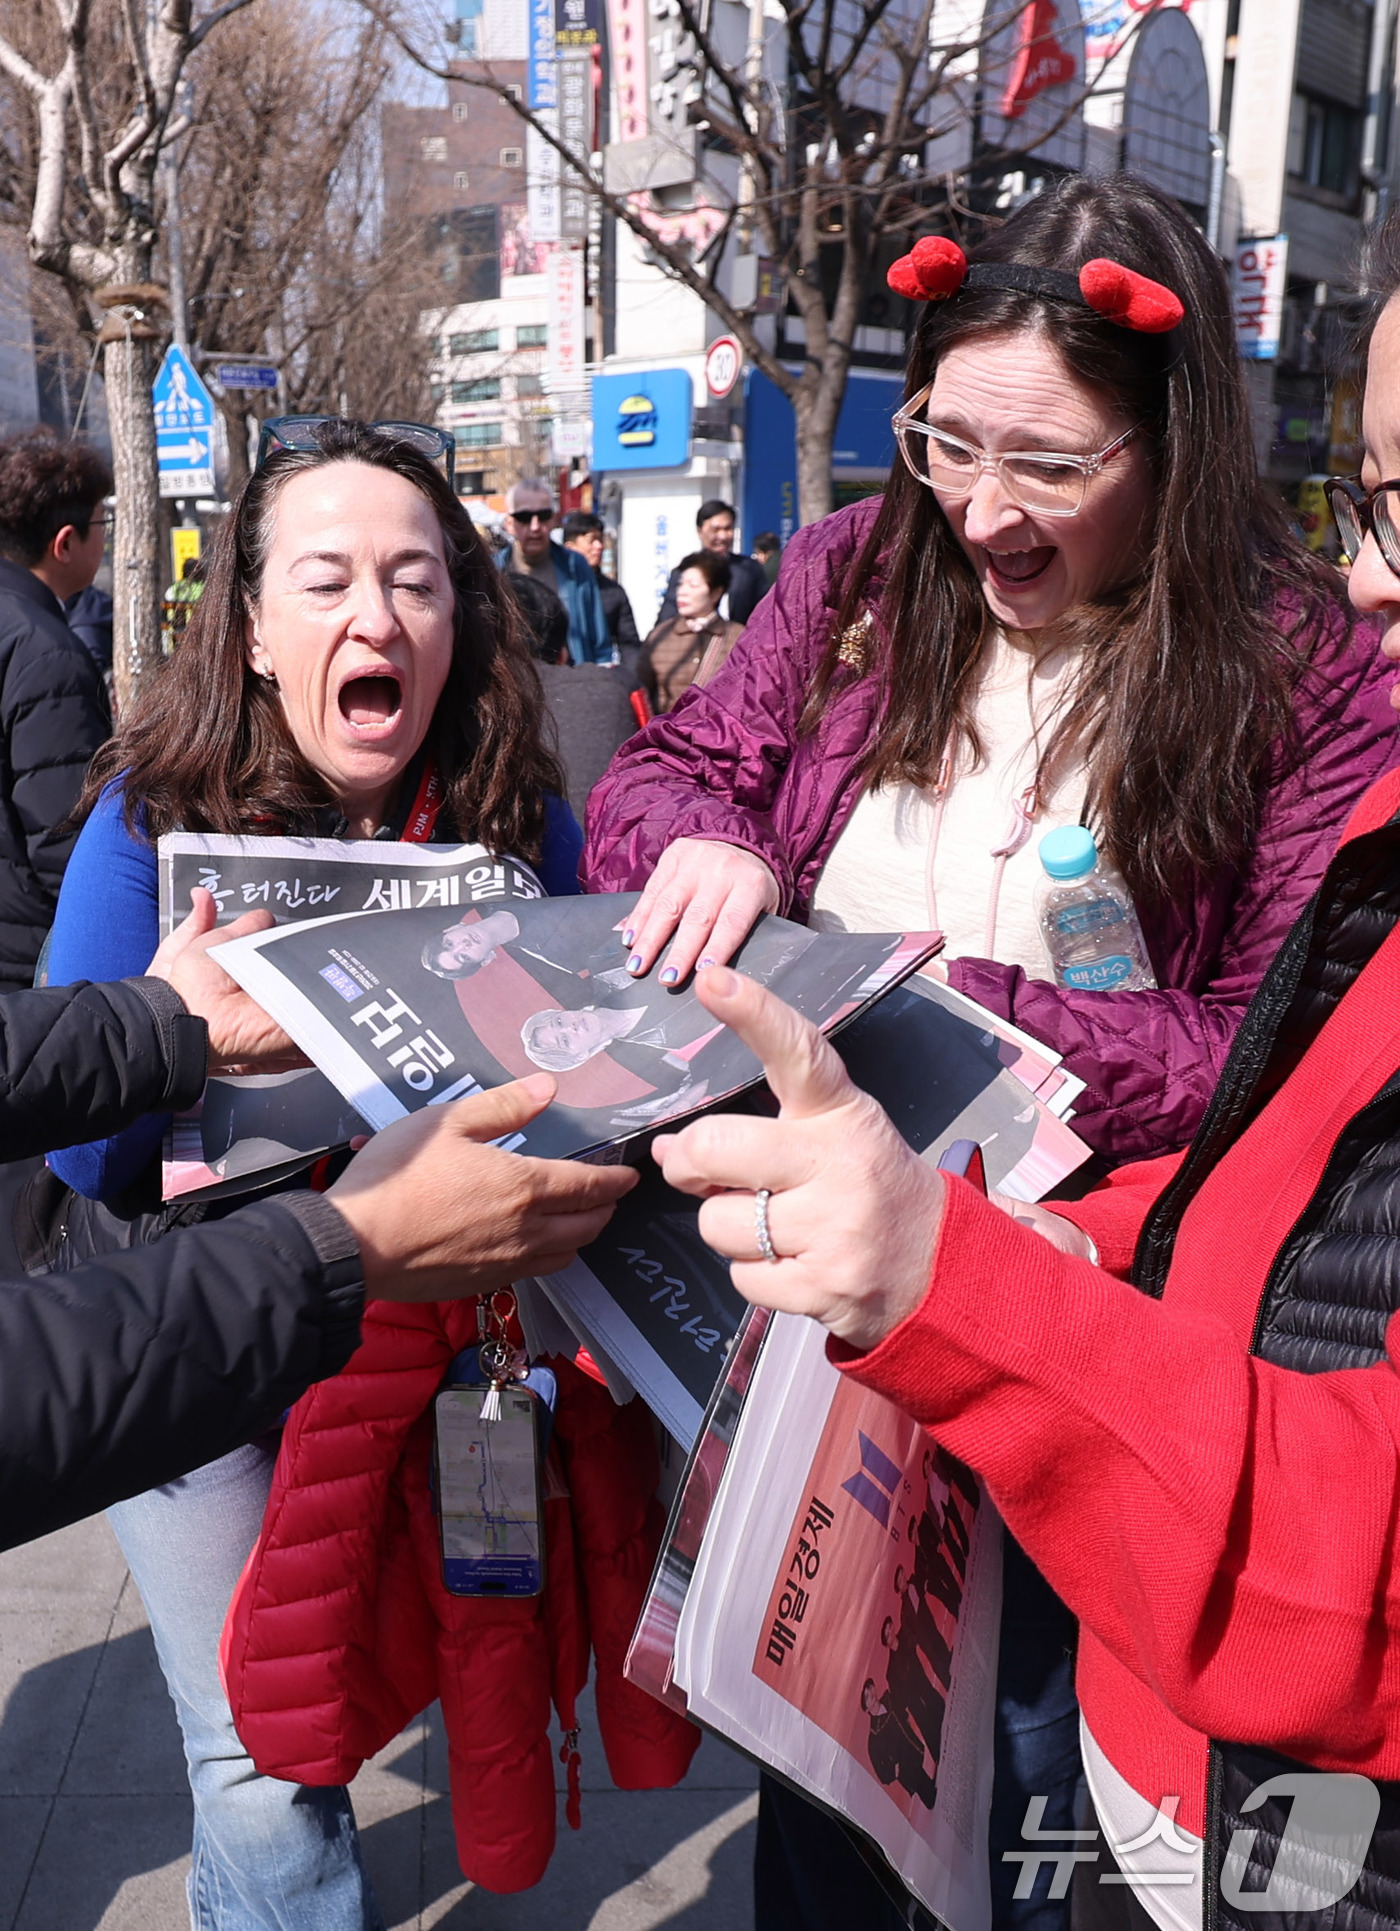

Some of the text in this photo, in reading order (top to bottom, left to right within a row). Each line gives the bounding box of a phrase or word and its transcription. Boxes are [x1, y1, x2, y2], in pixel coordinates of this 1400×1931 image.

[412, 776, 439, 836] PJM KTH
[241, 878, 341, 908] 터진다
[1070, 962, 1127, 984] 백산수
[617, 1247, 720, 1353] 터진다
[891, 1481, 912, 1542] BTS
[766, 1496, 834, 1667] 매일경제
